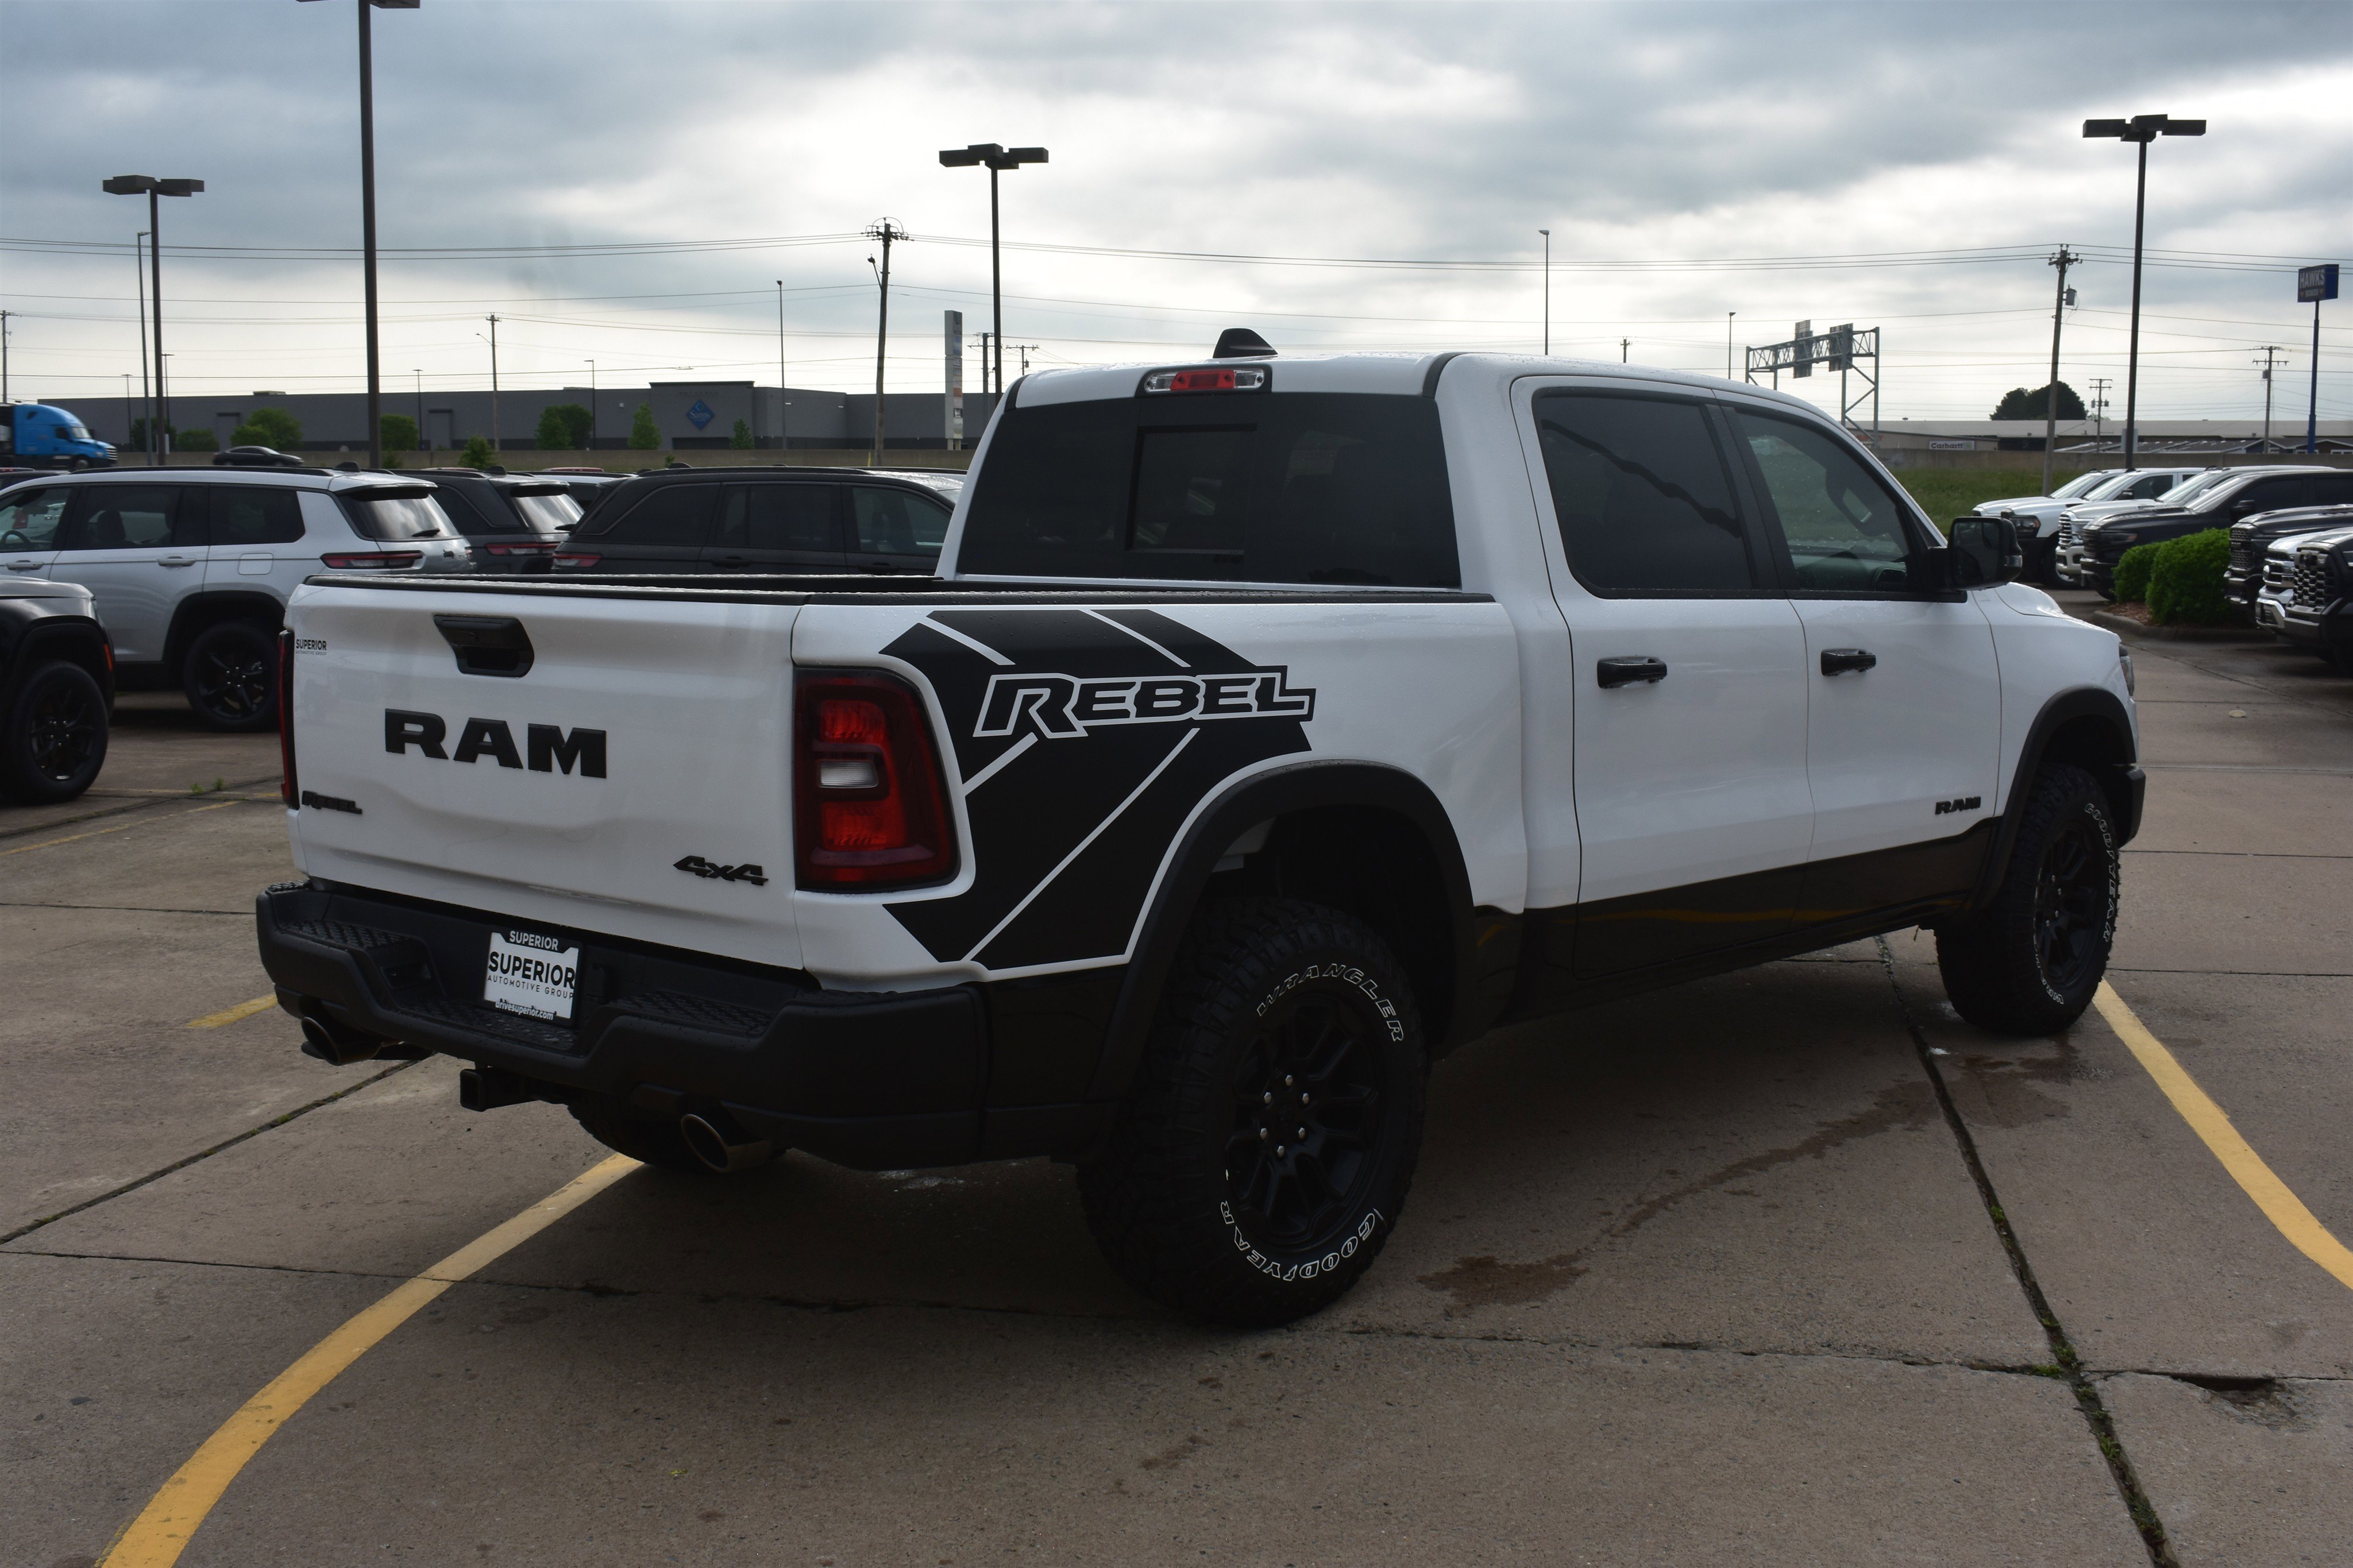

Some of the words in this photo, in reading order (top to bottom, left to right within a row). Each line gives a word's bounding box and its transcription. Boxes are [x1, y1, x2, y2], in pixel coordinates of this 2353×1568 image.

[296, 639, 327, 651] SUPERIOR
[972, 672, 1313, 739] REBEL
[384, 708, 607, 779] RAM
[1935, 795, 1981, 815] RAM
[673, 855, 769, 886] 4x4
[509, 930, 559, 951] SUPERIOR
[488, 951, 576, 990] SUPERIOR
[487, 975, 541, 992] AUTOMOTIVE
[544, 987, 574, 999] GROUP
[1256, 963, 1404, 1041] WRANGLER
[495, 1001, 554, 1021] drivesuperior.com
[1220, 1200, 1375, 1281] GOODYEAR
